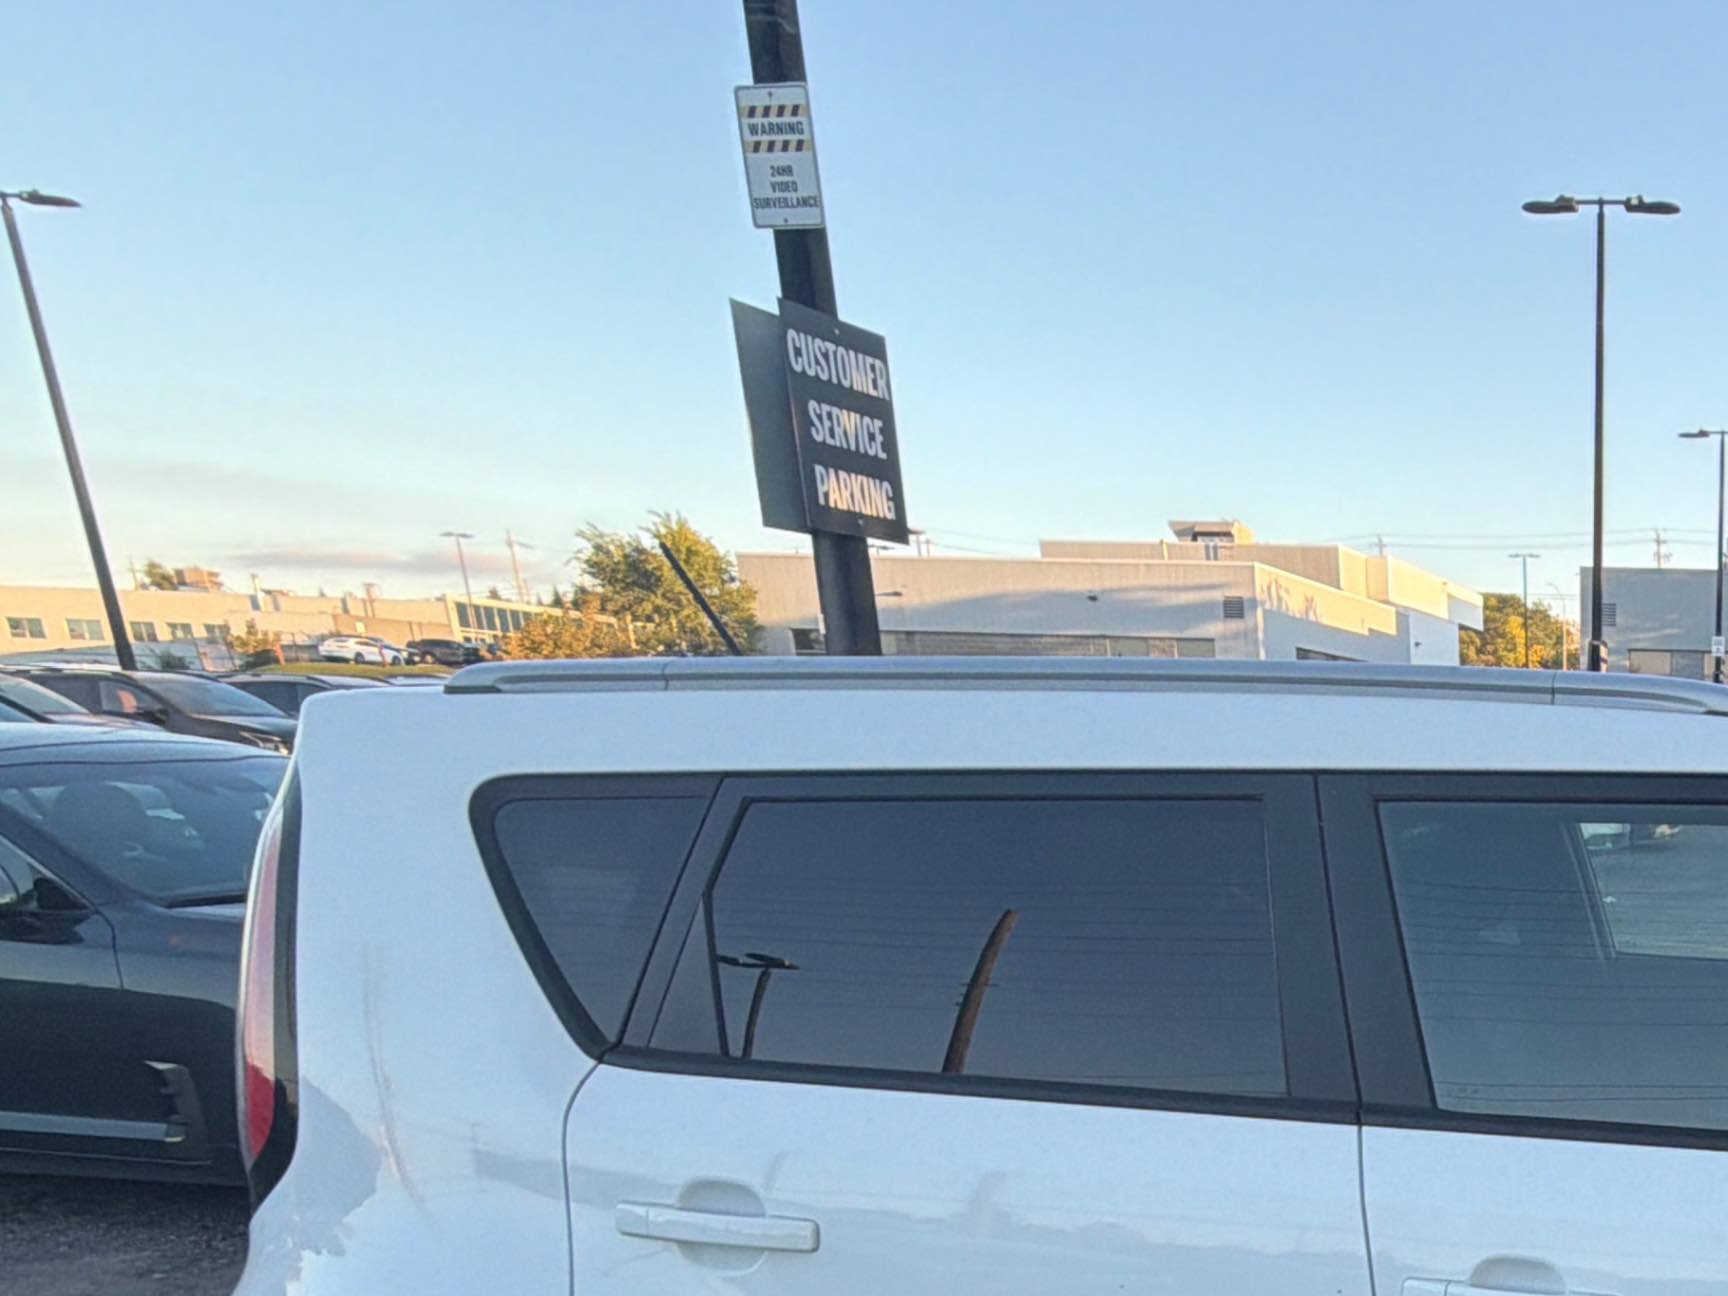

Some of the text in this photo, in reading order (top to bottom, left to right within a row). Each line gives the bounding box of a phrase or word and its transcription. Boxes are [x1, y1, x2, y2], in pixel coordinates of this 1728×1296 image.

[748, 121, 804, 136] WARNING
[769, 164, 794, 178] 24HR
[769, 180, 798, 193] VIDEO
[753, 195, 819, 208] SURVEILLANCE
[786, 328, 889, 400] CUSTOMER
[808, 400, 888, 459] SERVICE
[814, 464, 896, 520] PARKING
